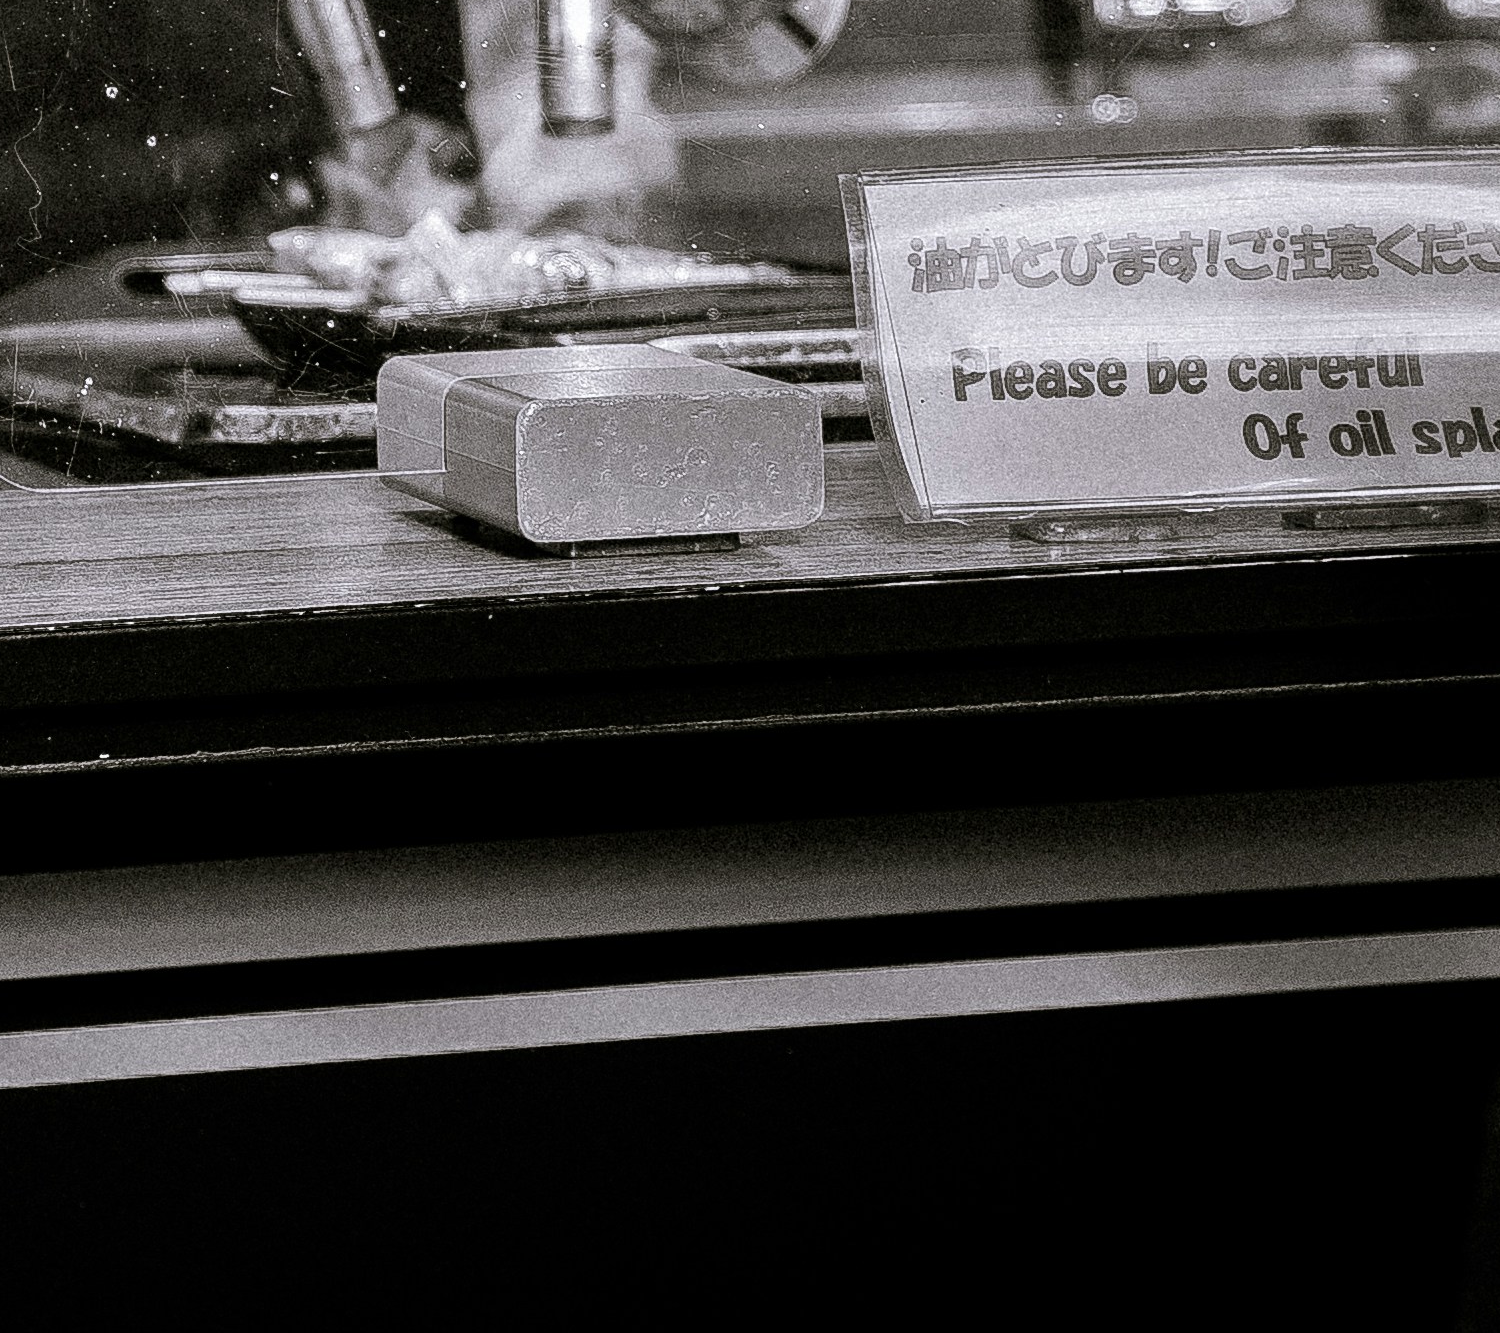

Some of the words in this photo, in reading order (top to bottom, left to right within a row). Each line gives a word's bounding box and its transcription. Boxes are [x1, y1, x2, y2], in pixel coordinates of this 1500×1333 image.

[951, 345, 1127, 402] Please
[1146, 342, 1209, 396] be
[1227, 337, 1425, 393] careful
[1242, 411, 1309, 463] Of
[1328, 408, 1396, 459] oil
